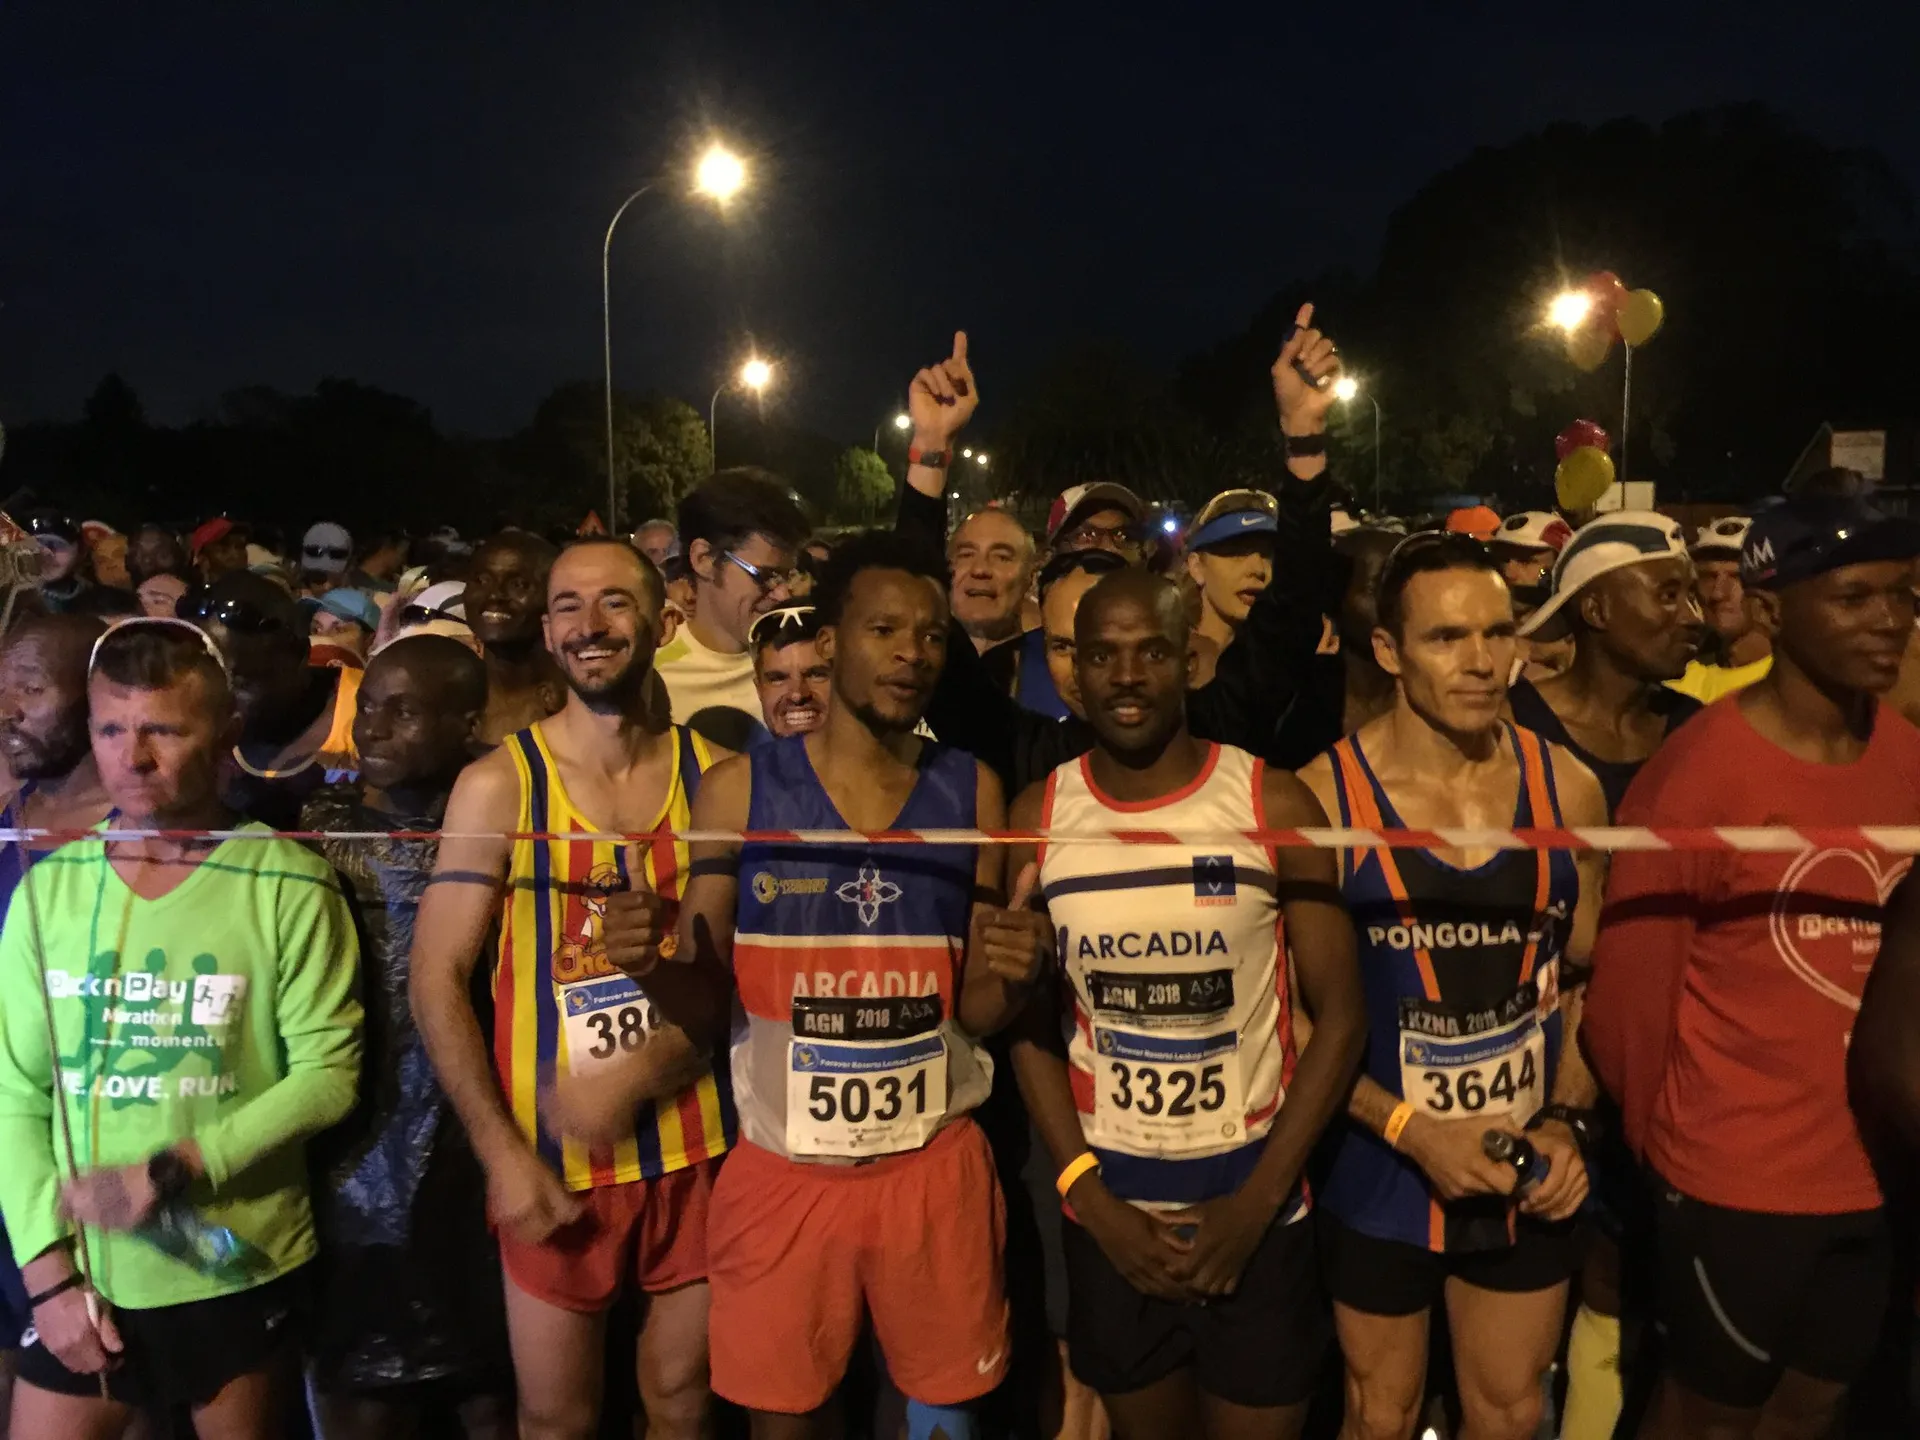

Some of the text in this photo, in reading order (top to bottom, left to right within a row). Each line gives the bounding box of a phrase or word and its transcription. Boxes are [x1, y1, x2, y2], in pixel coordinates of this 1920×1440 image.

[1078, 929, 1229, 960] ARCADIA
[1367, 921, 1521, 950] PONGOLA
[793, 970, 940, 998] ARCADIA
[1148, 984, 1181, 1005] 2018
[803, 1013, 845, 1033] AGN
[856, 1008, 890, 1028] 2018
[1408, 1010, 1460, 1036] KZNA
[1110, 1062, 1226, 1116] 3325
[1423, 1047, 1536, 1111] 3644
[808, 1068, 928, 1123] 5031
